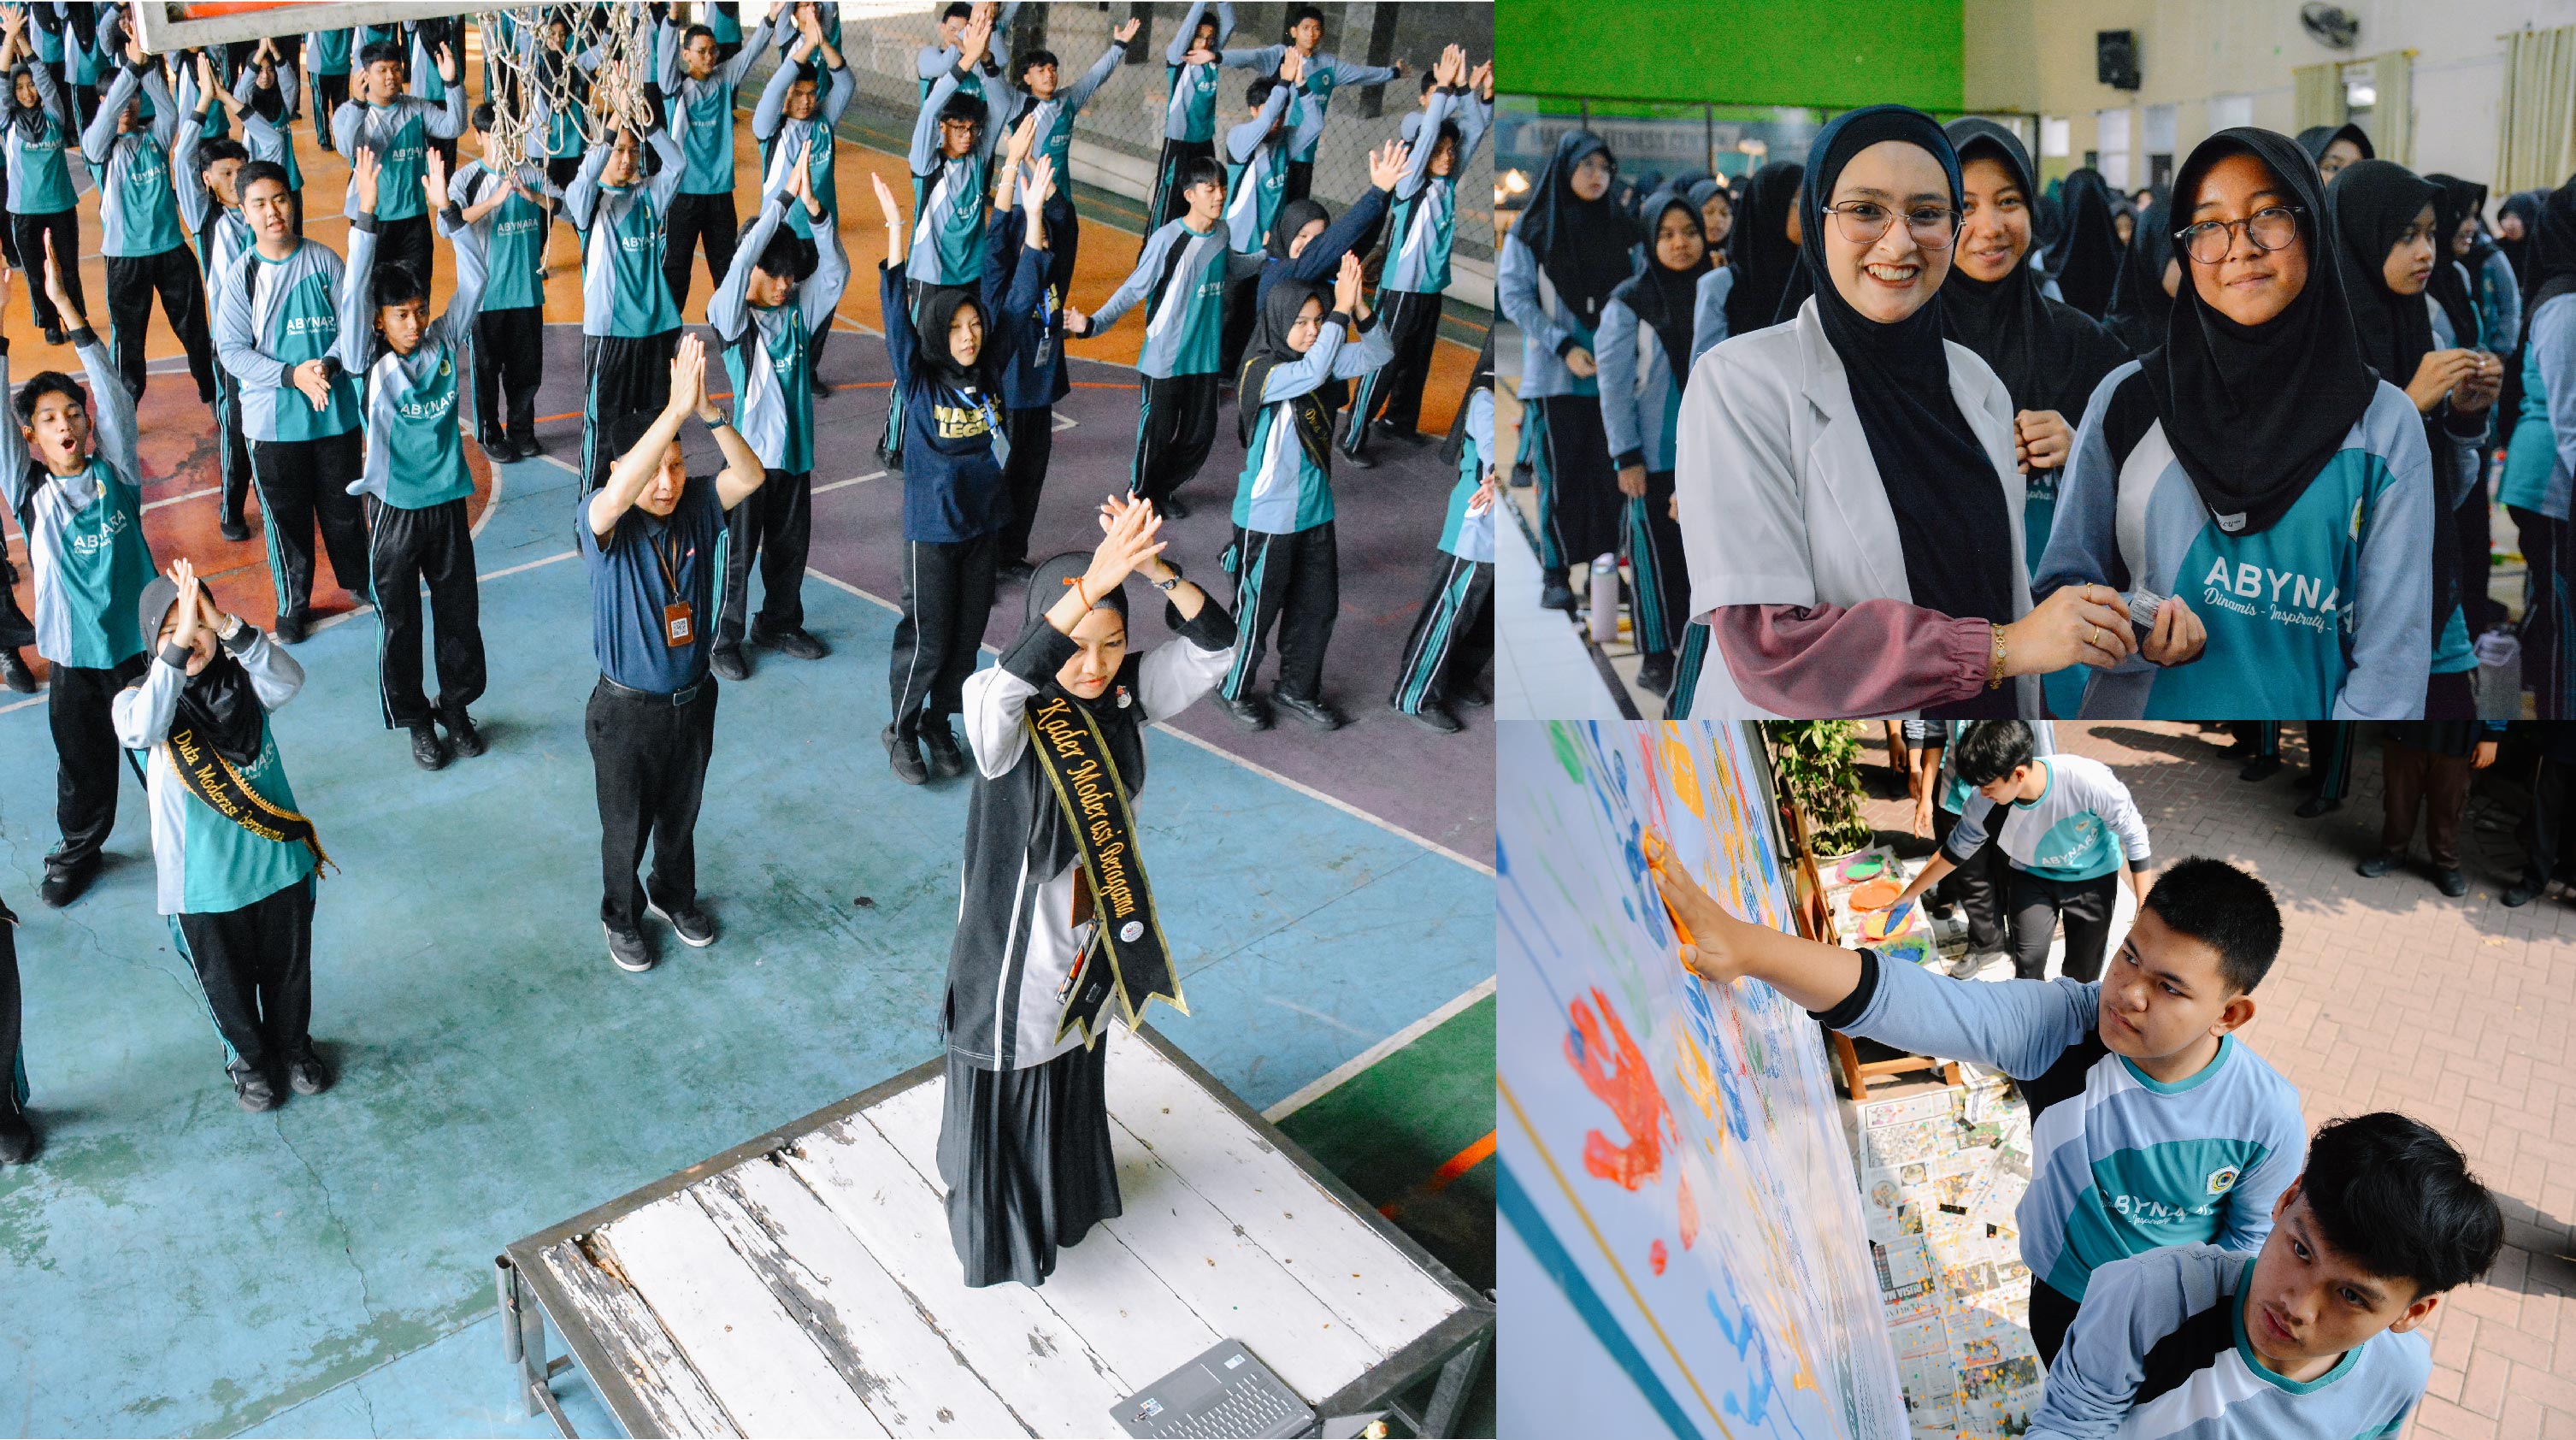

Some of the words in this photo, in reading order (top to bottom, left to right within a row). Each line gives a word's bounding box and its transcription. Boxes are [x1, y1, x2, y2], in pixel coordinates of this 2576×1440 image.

[286, 316, 337, 331] ABYNAR
[400, 390, 456, 416] ABYNAR
[2204, 587, 2257, 617] Dinamis
[173, 729, 200, 766] Duta
[194, 763, 245, 817] Moderasi
[1036, 697, 1088, 759] Kader
[1099, 841, 1136, 918] Beragama
